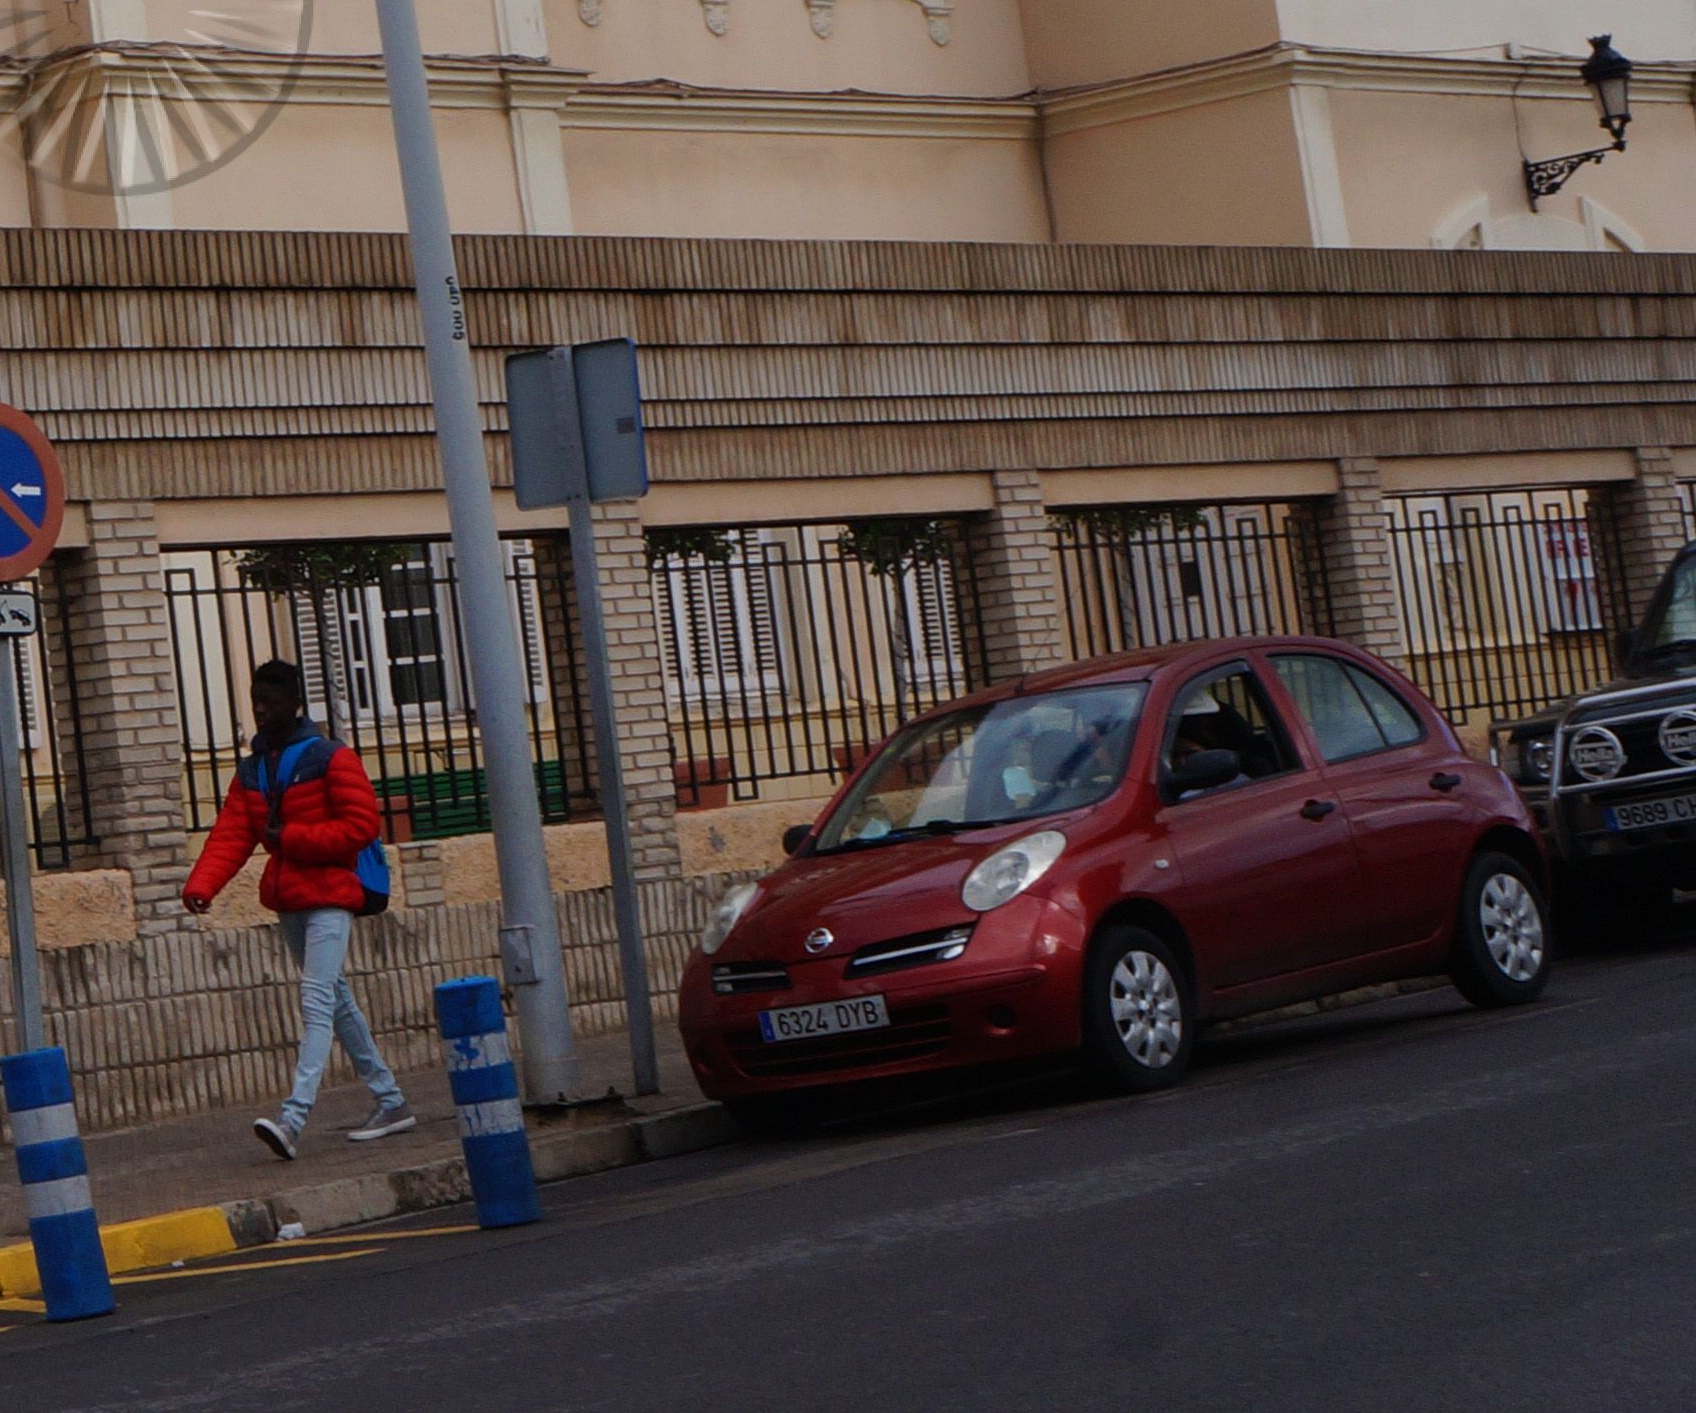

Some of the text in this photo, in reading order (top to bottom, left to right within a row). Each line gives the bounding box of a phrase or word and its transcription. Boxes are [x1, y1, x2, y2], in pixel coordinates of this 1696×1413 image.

[1617, 802, 1668, 827] 9689
[776, 1000, 878, 1035] 6324 DYB
